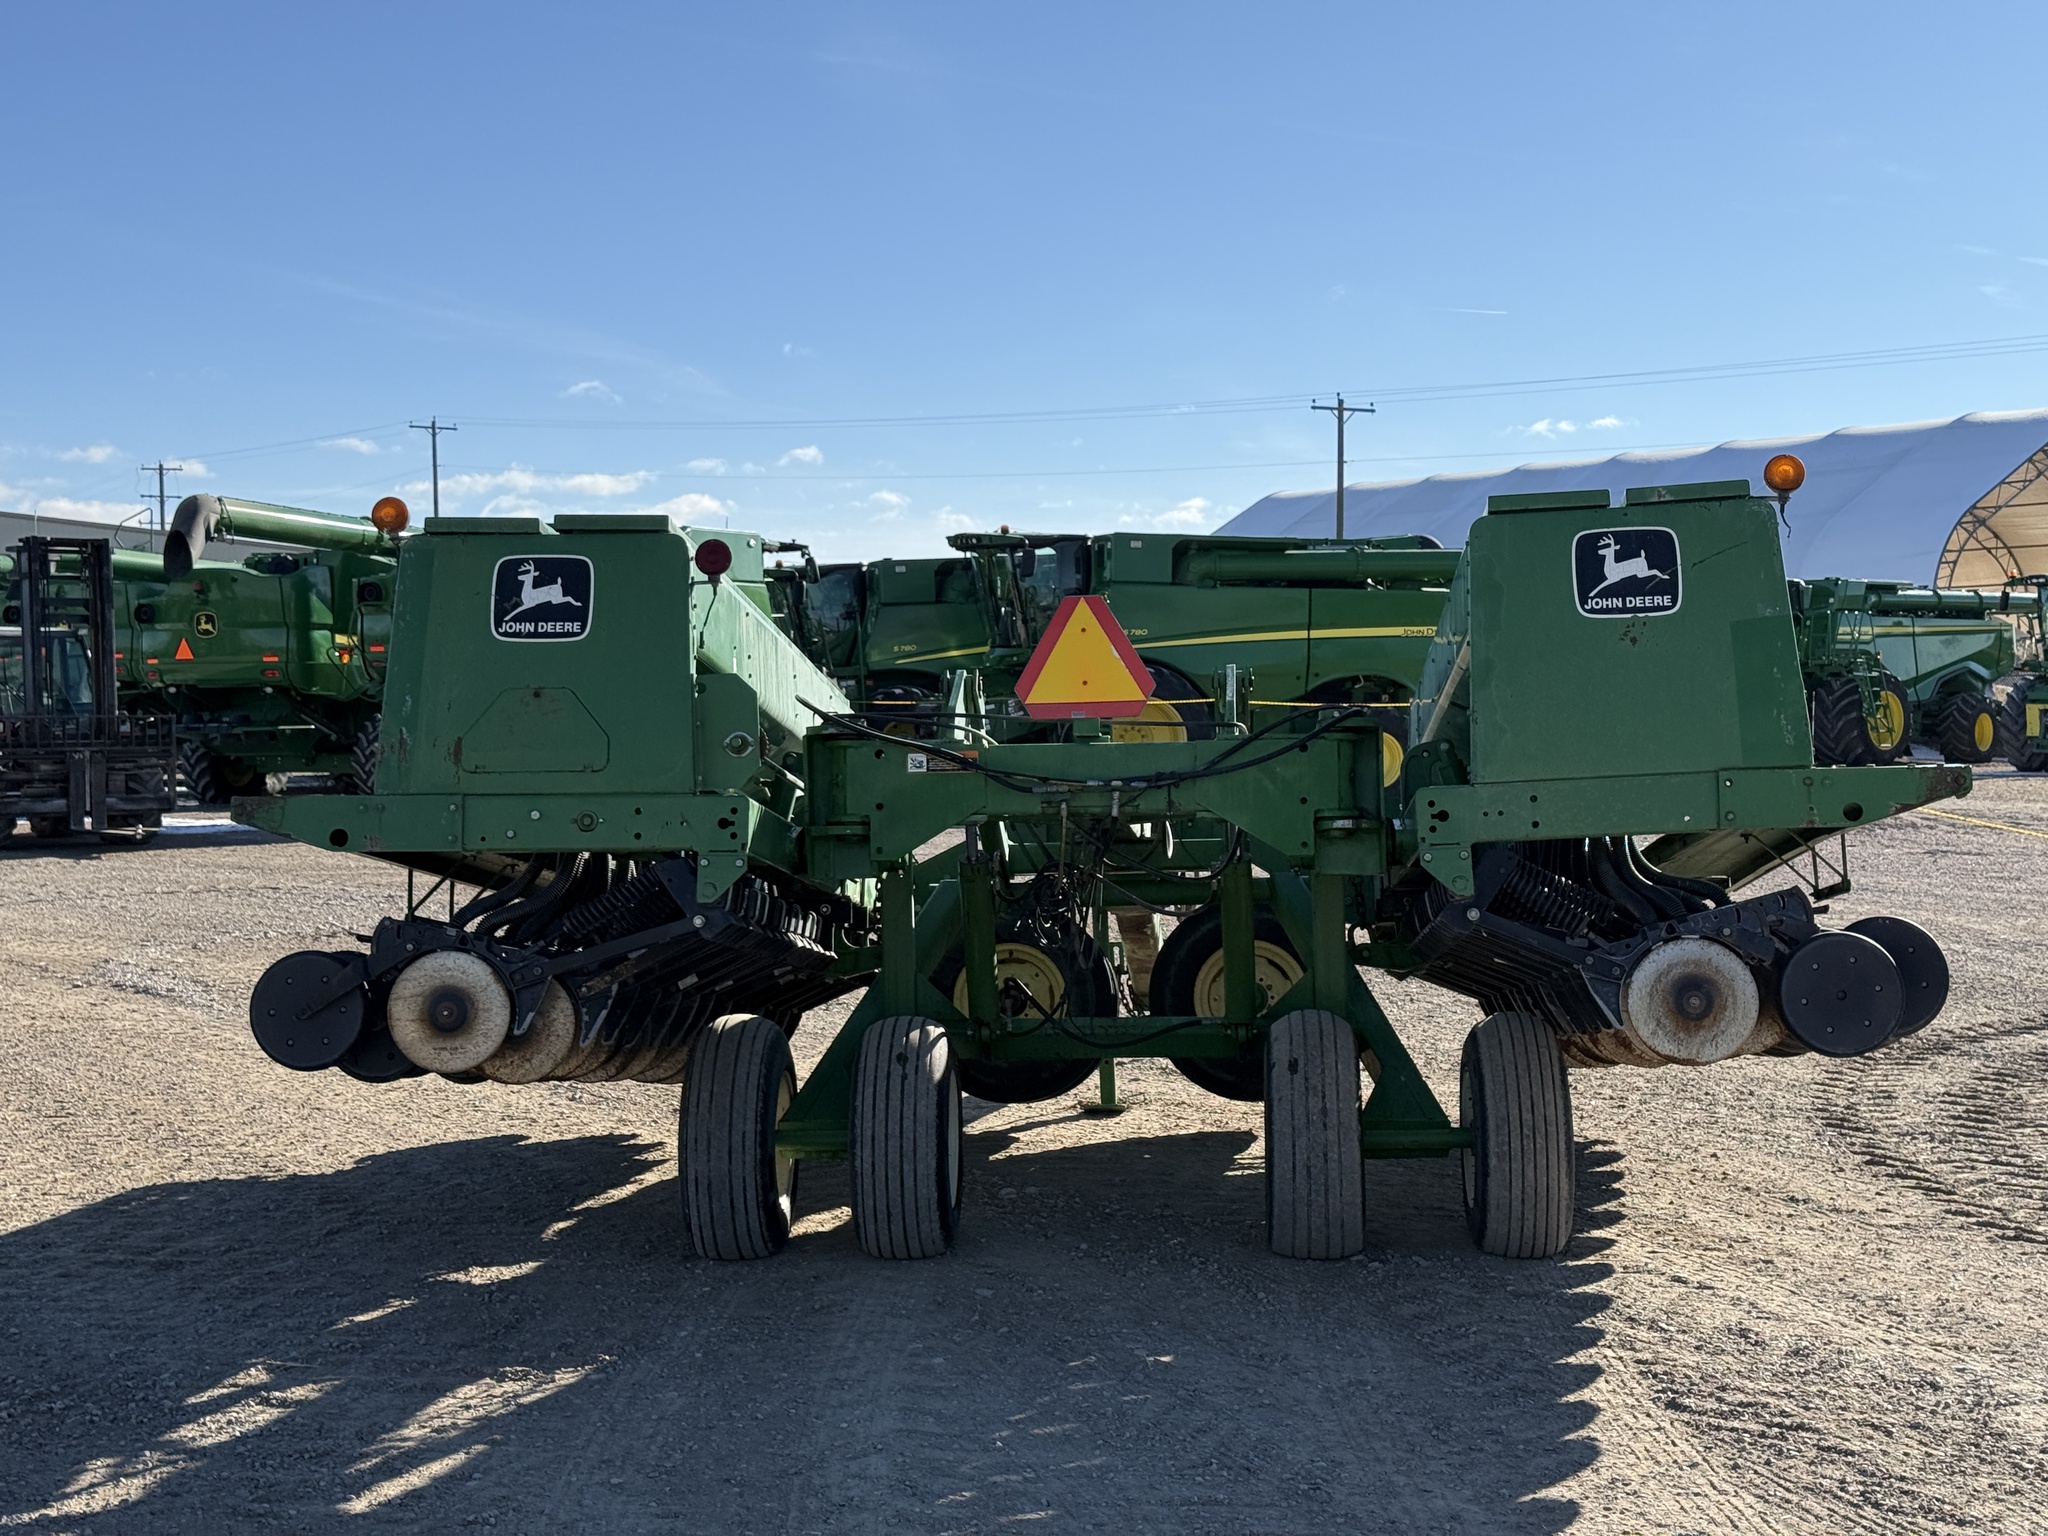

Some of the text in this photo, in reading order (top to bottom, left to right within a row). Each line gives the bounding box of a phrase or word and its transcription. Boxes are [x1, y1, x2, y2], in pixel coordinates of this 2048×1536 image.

[1584, 595, 1673, 610] JOHN DEERE
[498, 622, 582, 633] JOHN DEERE
[1401, 628, 1425, 636] JOHN
[900, 644, 917, 652] 780
